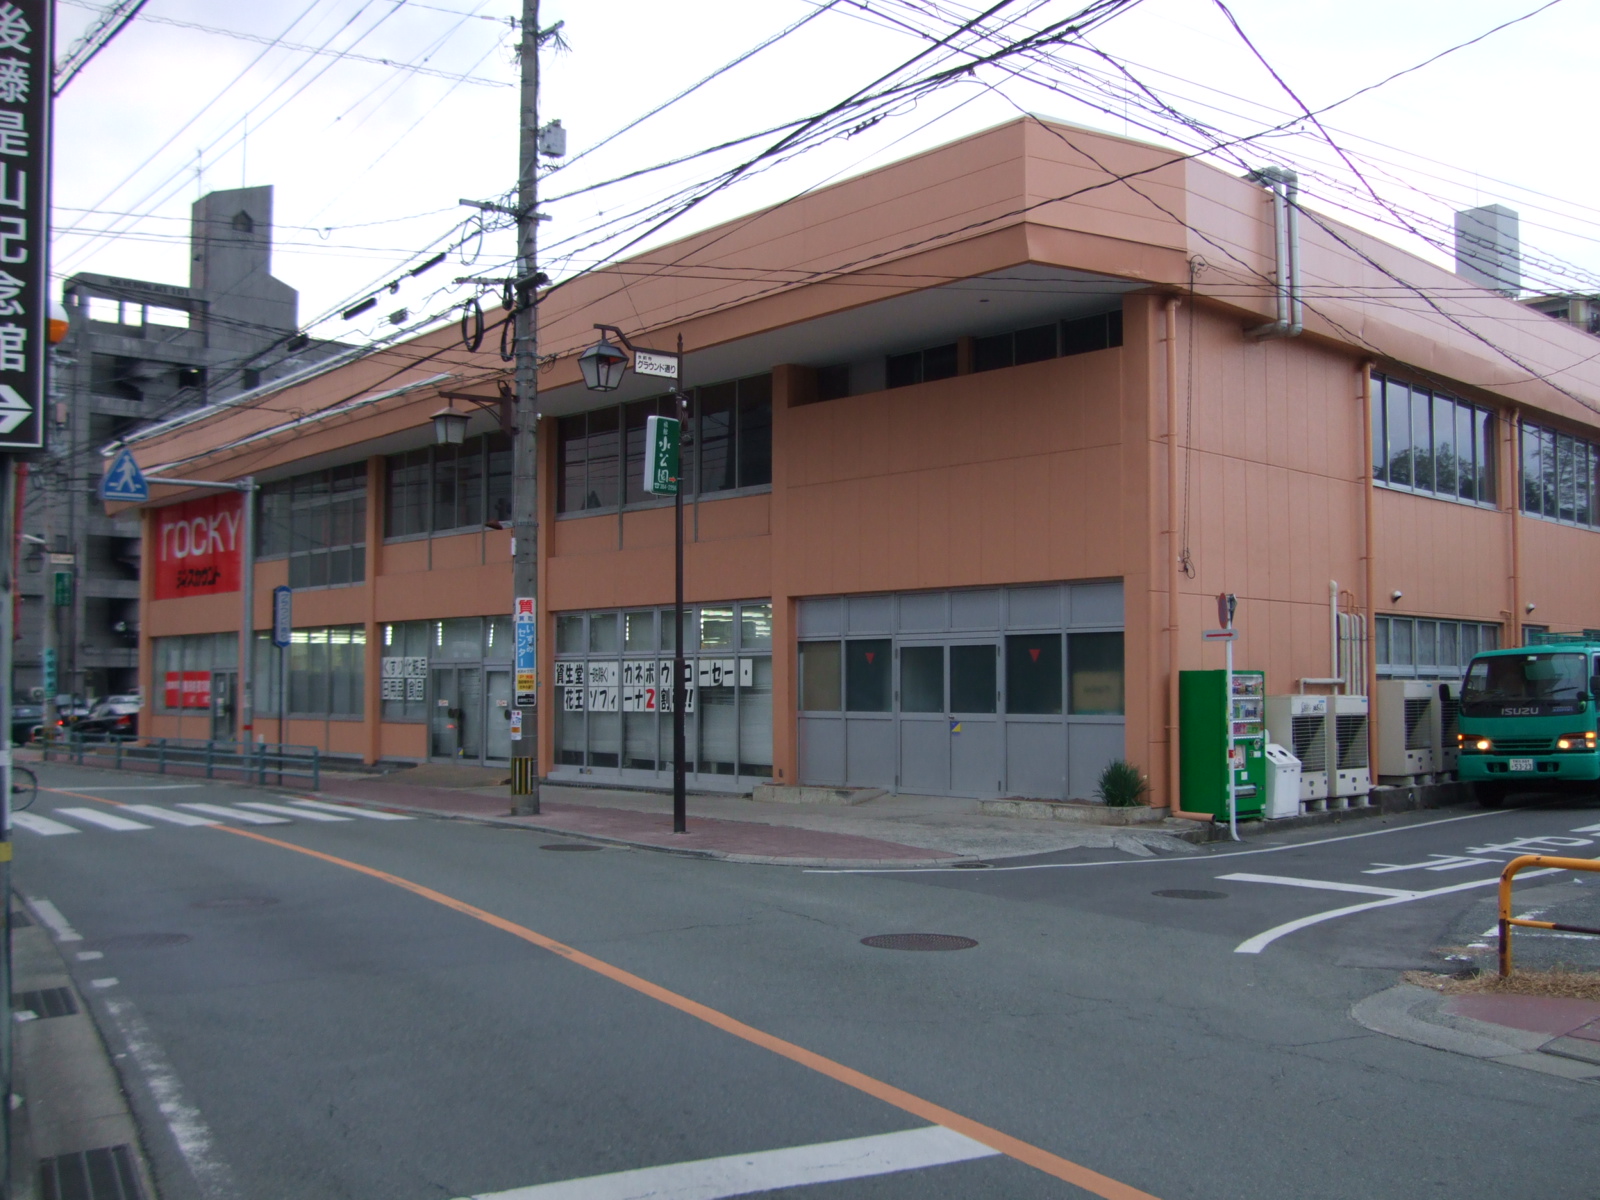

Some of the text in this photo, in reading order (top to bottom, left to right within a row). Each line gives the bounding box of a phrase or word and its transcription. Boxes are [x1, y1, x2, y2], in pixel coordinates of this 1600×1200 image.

[637, 360, 676, 374] グラウンド通り
[519, 600, 533, 614] 質
[518, 628, 526, 667] センター
[1501, 707, 1539, 716] ISUZU
